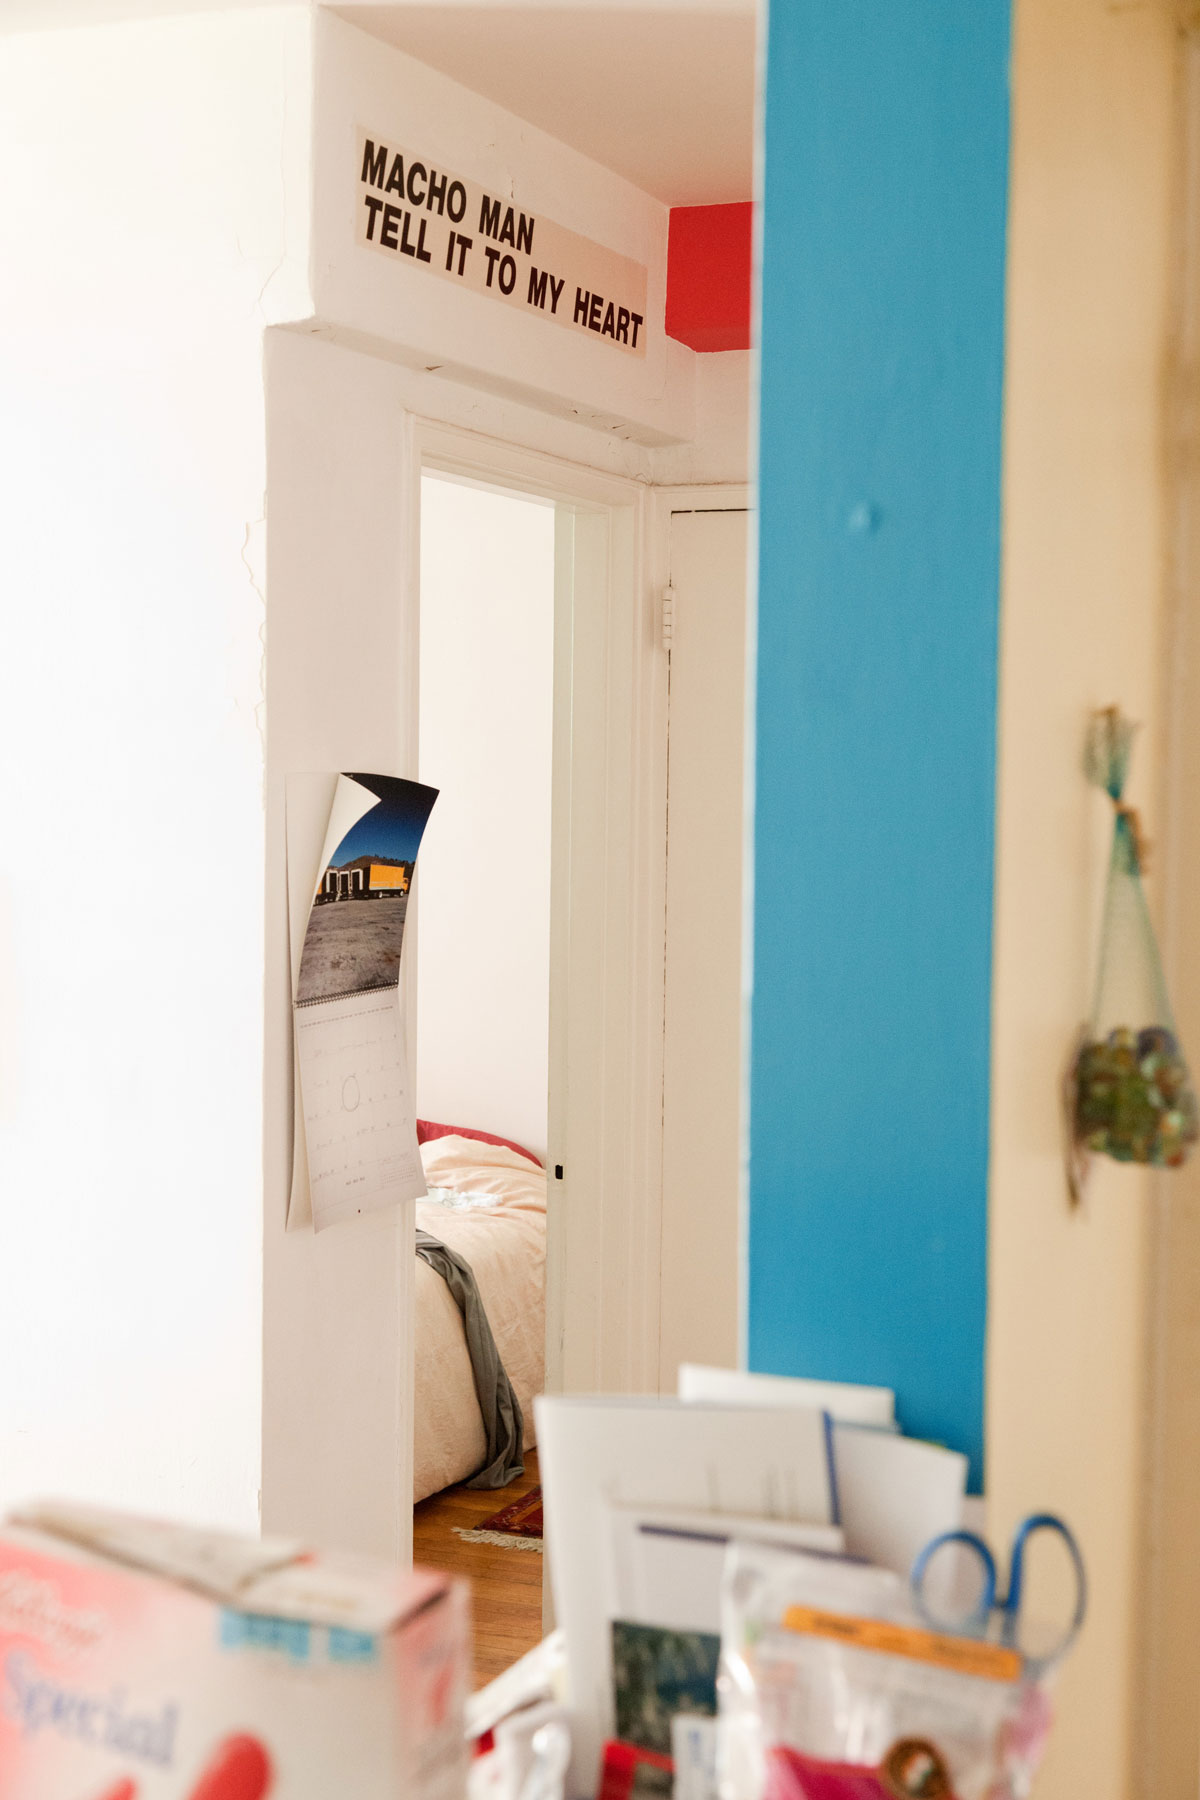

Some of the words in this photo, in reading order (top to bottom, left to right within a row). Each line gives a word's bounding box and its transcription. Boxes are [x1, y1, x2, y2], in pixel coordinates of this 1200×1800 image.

[361, 139, 467, 223] MACHO
[479, 194, 535, 255] MAN
[364, 195, 431, 263] TELL
[446, 231, 473, 276] IT
[485, 246, 517, 295] TO
[527, 266, 565, 314] MY
[573, 287, 644, 348] HEART
